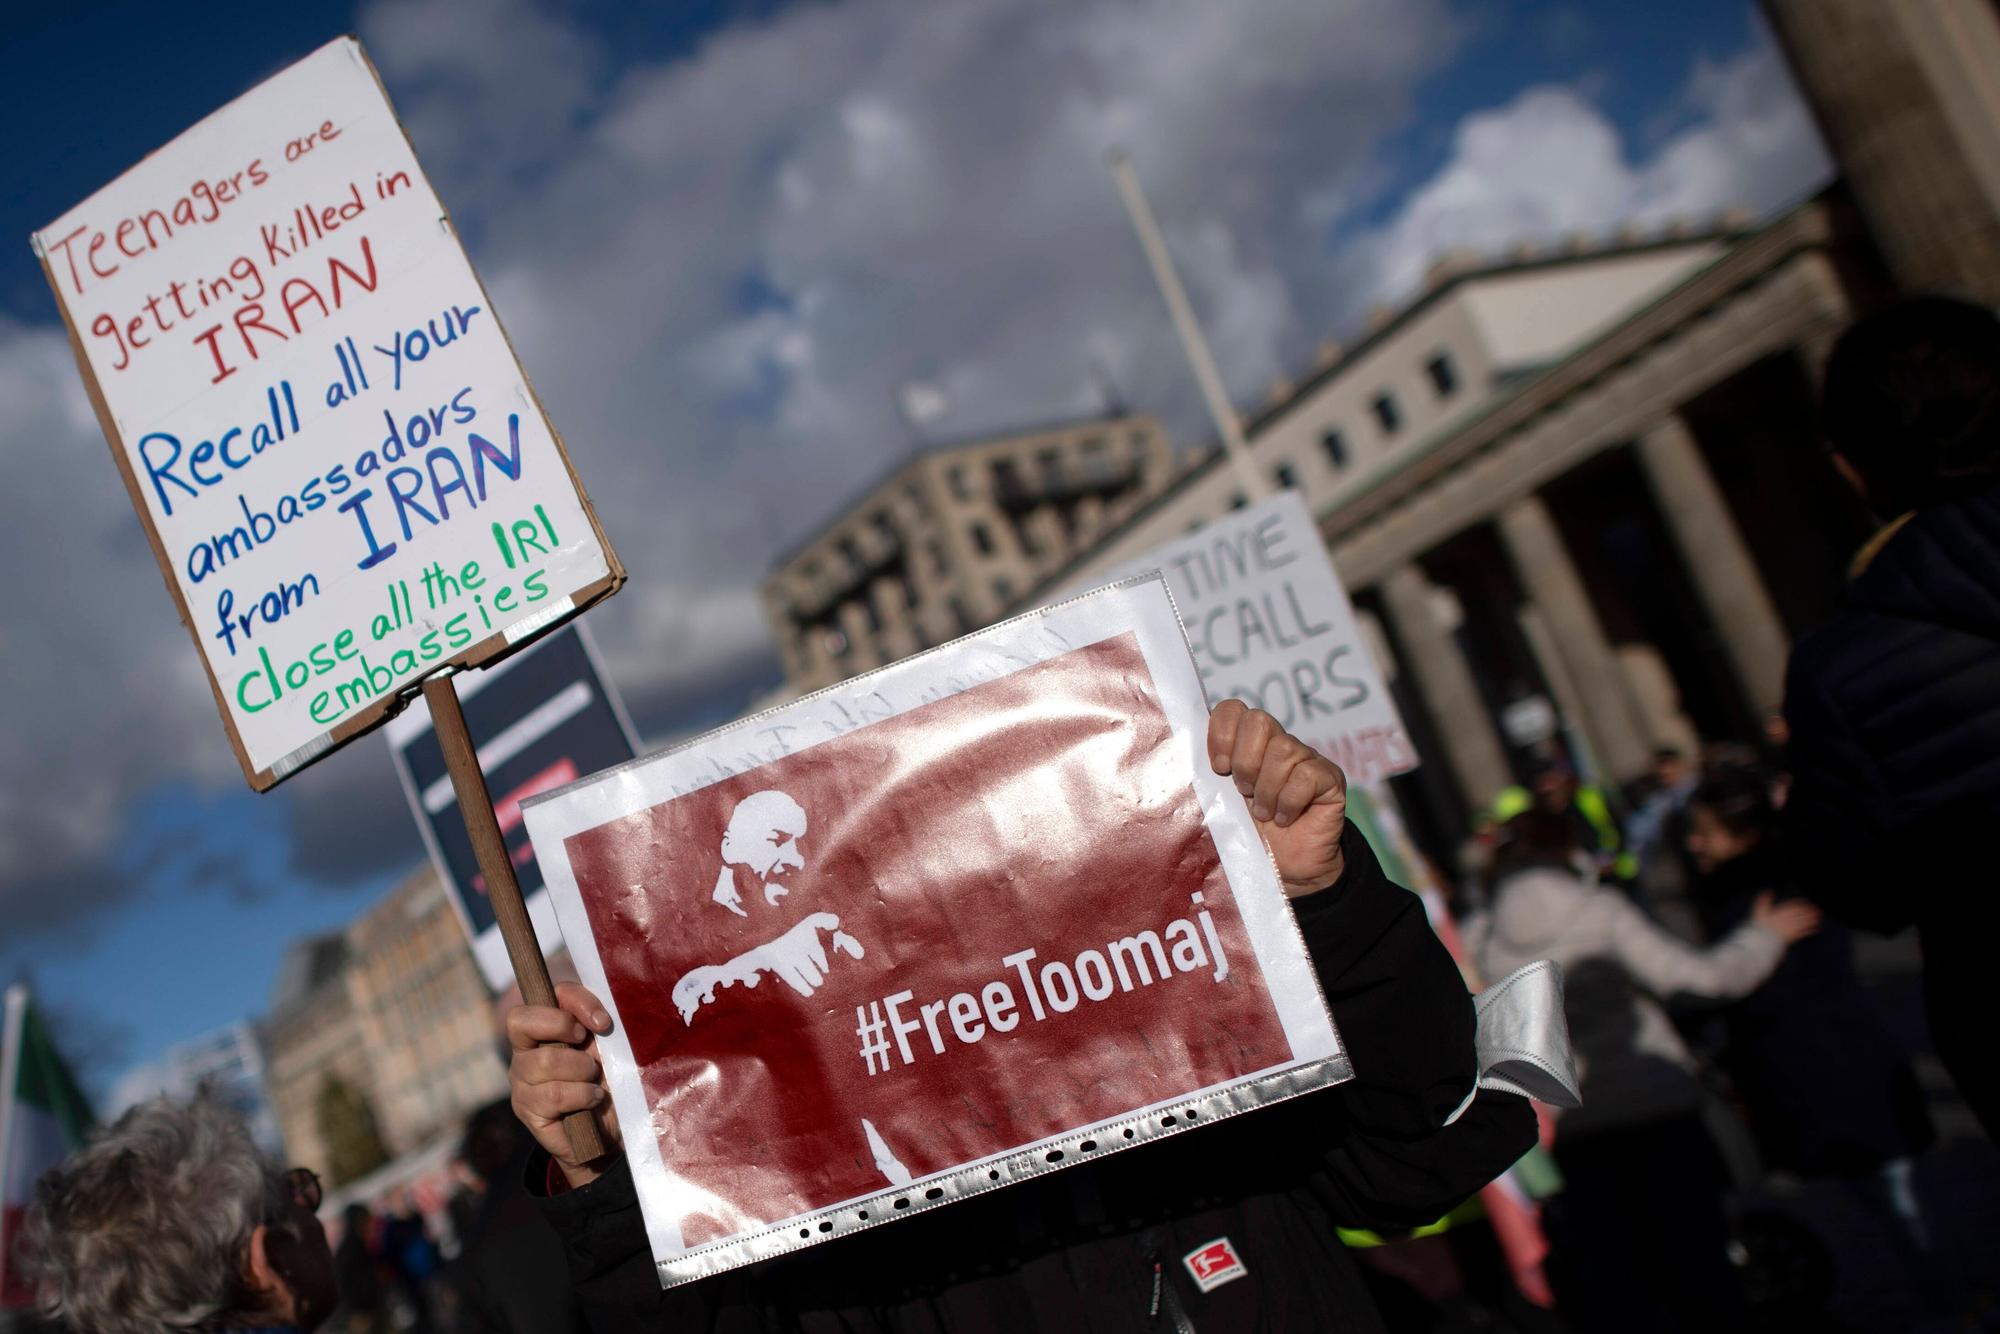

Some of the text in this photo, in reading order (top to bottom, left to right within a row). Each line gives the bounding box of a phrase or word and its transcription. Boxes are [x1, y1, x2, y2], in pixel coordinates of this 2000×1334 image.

[49, 119, 342, 295] Teenagers are
[92, 256, 266, 370] getting
[376, 170, 411, 200] in
[193, 236, 379, 385] IRAN
[138, 304, 481, 516] Recall all your
[186, 386, 478, 584] ambassadors
[215, 412, 521, 657] from IRAN
[371, 579, 413, 641] all
[421, 560, 487, 609] the
[491, 504, 560, 570] IRI
[308, 568, 549, 725] embassies
[856, 891, 1229, 1076] #FreeToomaj
